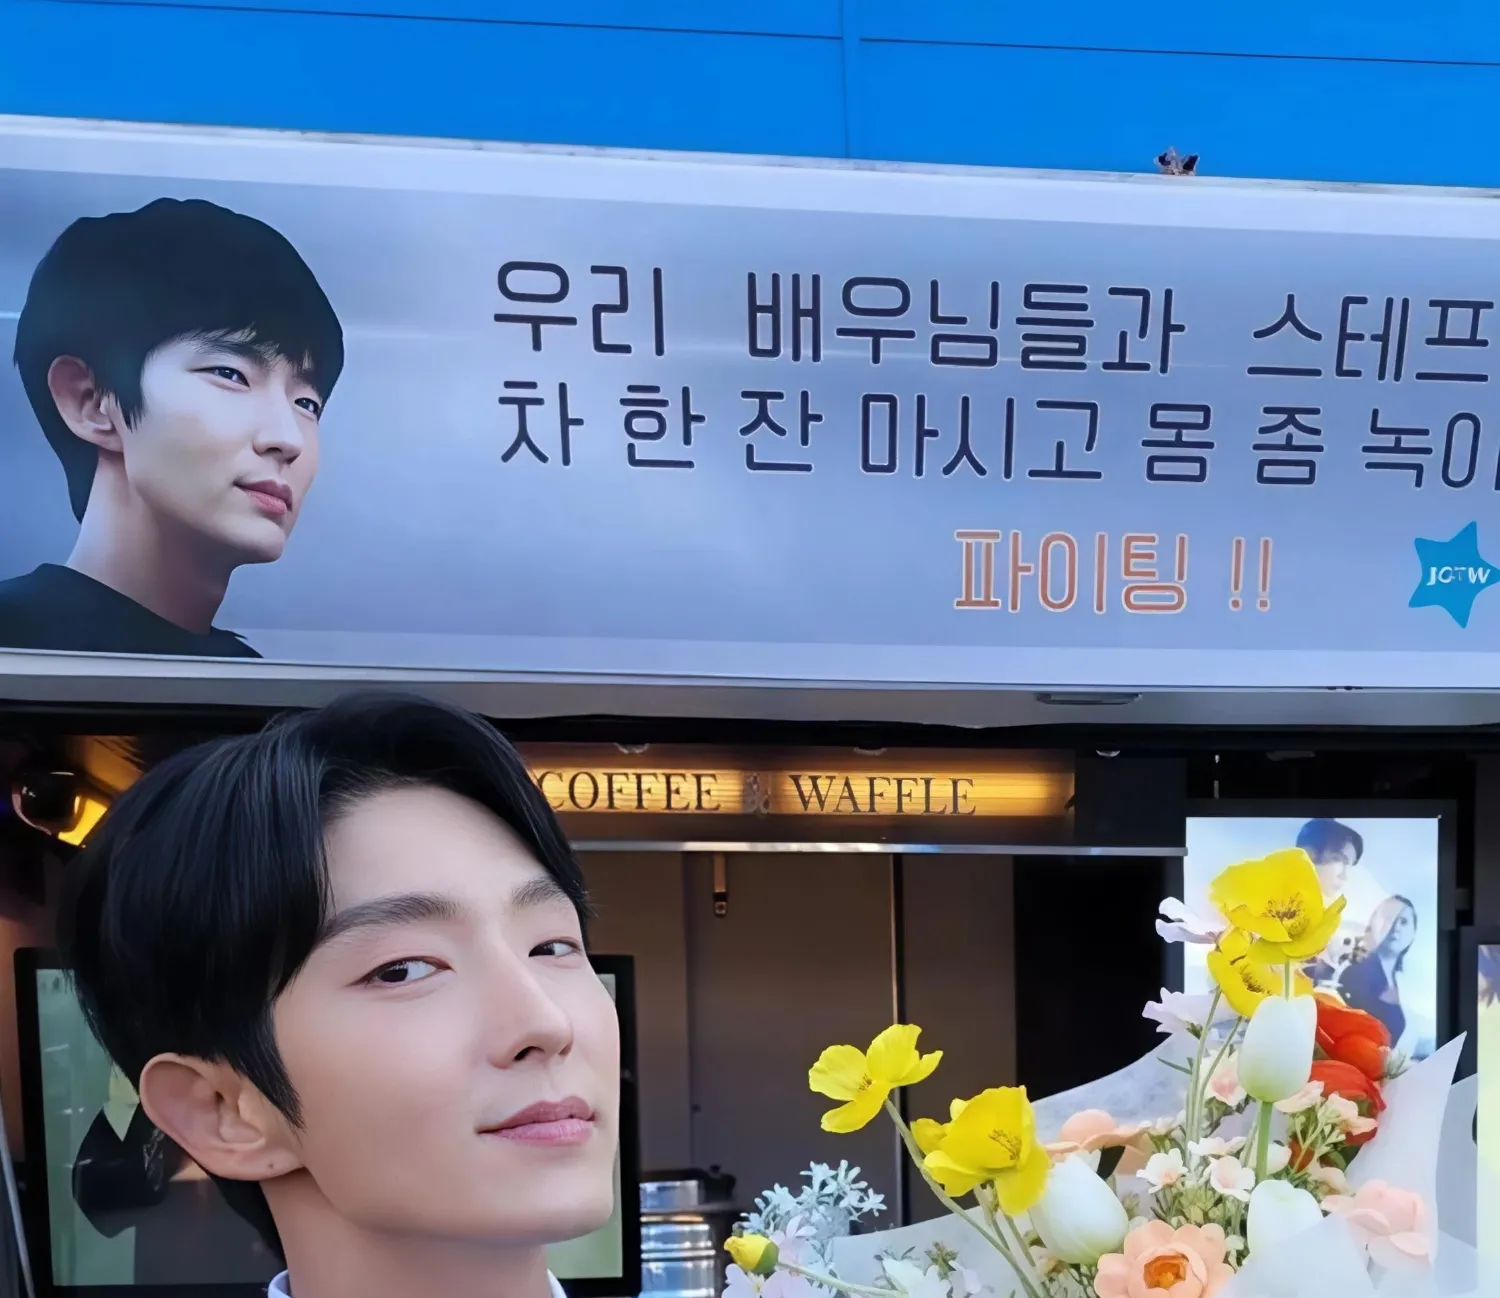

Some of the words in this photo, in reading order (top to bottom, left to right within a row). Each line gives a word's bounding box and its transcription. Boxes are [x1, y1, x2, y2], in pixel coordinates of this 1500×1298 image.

[493, 260, 665, 358] 우리
[746, 271, 1186, 374] 배우님들과
[1246, 292, 1495, 382] 스테프
[497, 380, 585, 467] 차
[619, 384, 706, 469] 한
[738, 389, 824, 472] 잔
[860, 392, 1103, 480] 마시고
[1141, 403, 1215, 483] 몸
[1252, 406, 1324, 485] 좀
[954, 529, 1188, 614] 파이팅
[538, 770, 721, 812] COFFEE
[788, 774, 977, 816] WAFFLE
